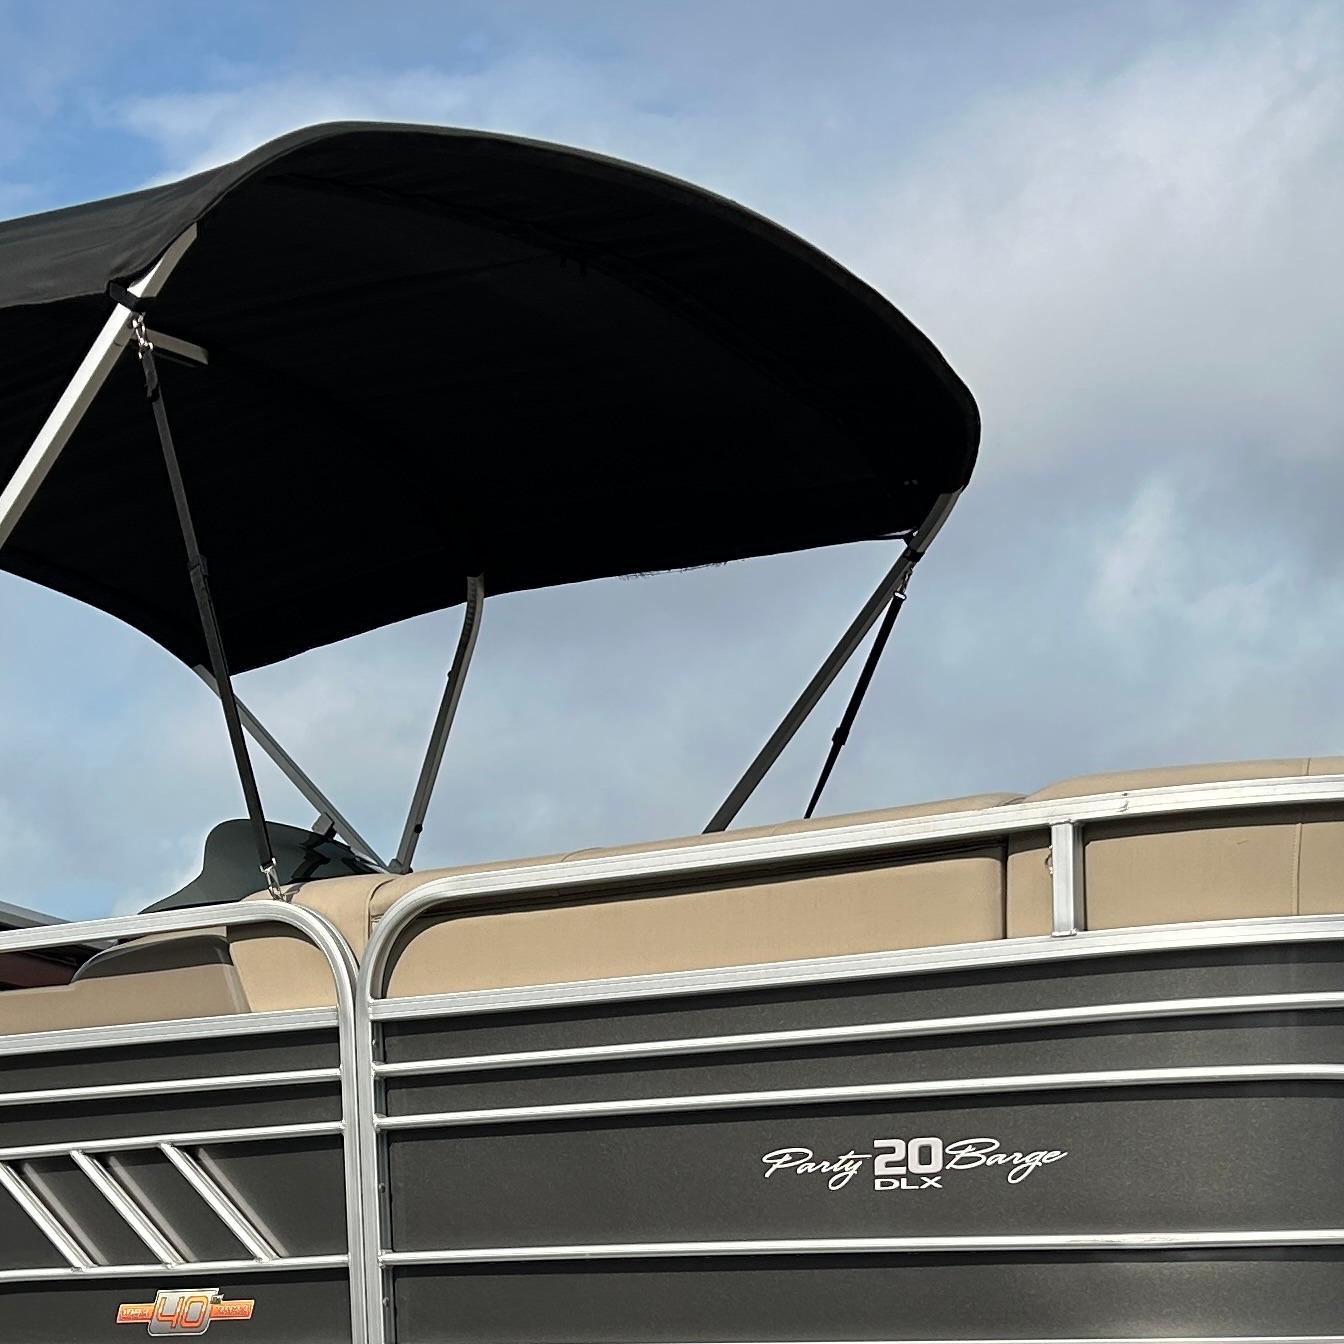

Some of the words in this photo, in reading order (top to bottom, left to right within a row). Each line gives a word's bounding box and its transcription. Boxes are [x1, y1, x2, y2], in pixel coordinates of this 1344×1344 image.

[762, 1148, 873, 1190] Party
[873, 1137, 943, 1176] 20
[945, 1137, 1068, 1184] Barge
[874, 1177, 943, 1190] DLX
[157, 1296, 208, 1329] 40
